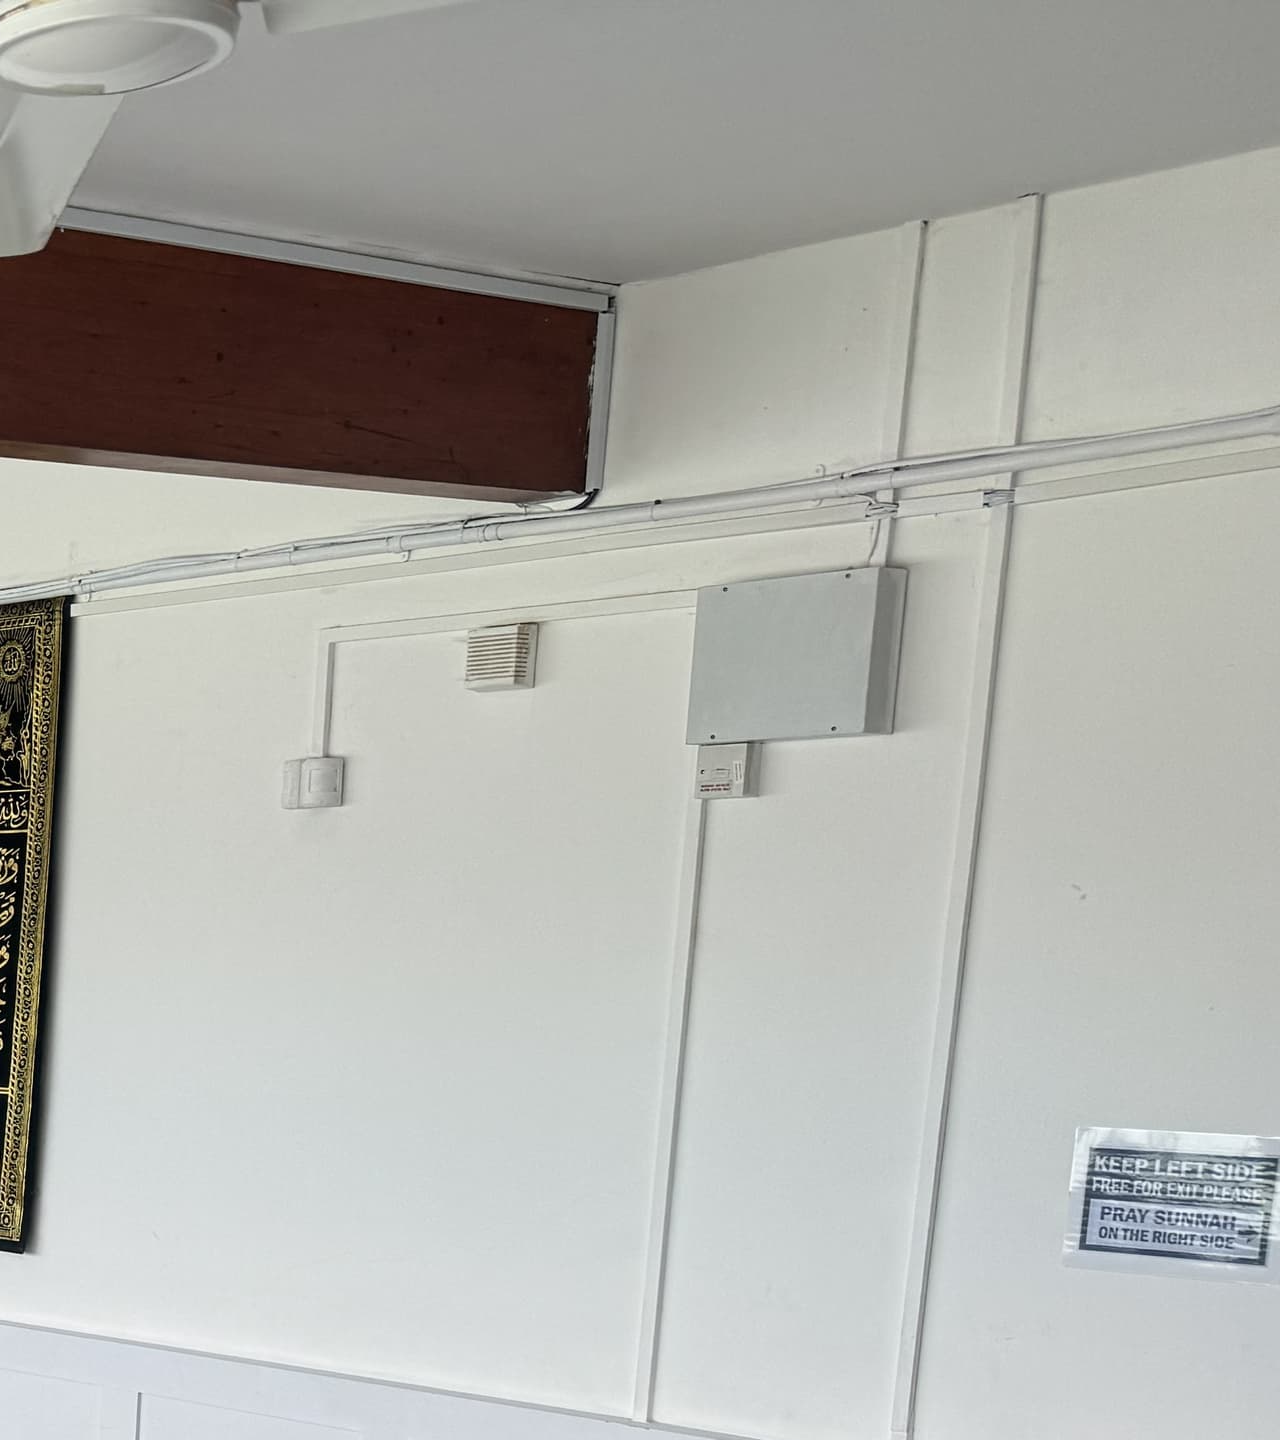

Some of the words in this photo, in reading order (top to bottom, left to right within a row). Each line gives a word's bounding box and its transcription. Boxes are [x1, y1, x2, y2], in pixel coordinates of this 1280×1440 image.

[1094, 1155, 1148, 1175] KEEP
[1154, 1159, 1208, 1178] LEFT
[1212, 1163, 1265, 1182] SIDE
[1092, 1176, 1130, 1193] FREE
[1133, 1179, 1162, 1196] FOR
[1167, 1182, 1199, 1198] EXIT
[1100, 1205, 1150, 1223] PRAY
[1153, 1209, 1236, 1231] SUNNAH
[1098, 1226, 1119, 1239] ON
[1122, 1227, 1149, 1242] THE
[1152, 1230, 1196, 1246] RIGHT
[1199, 1234, 1235, 1250] SIDE
